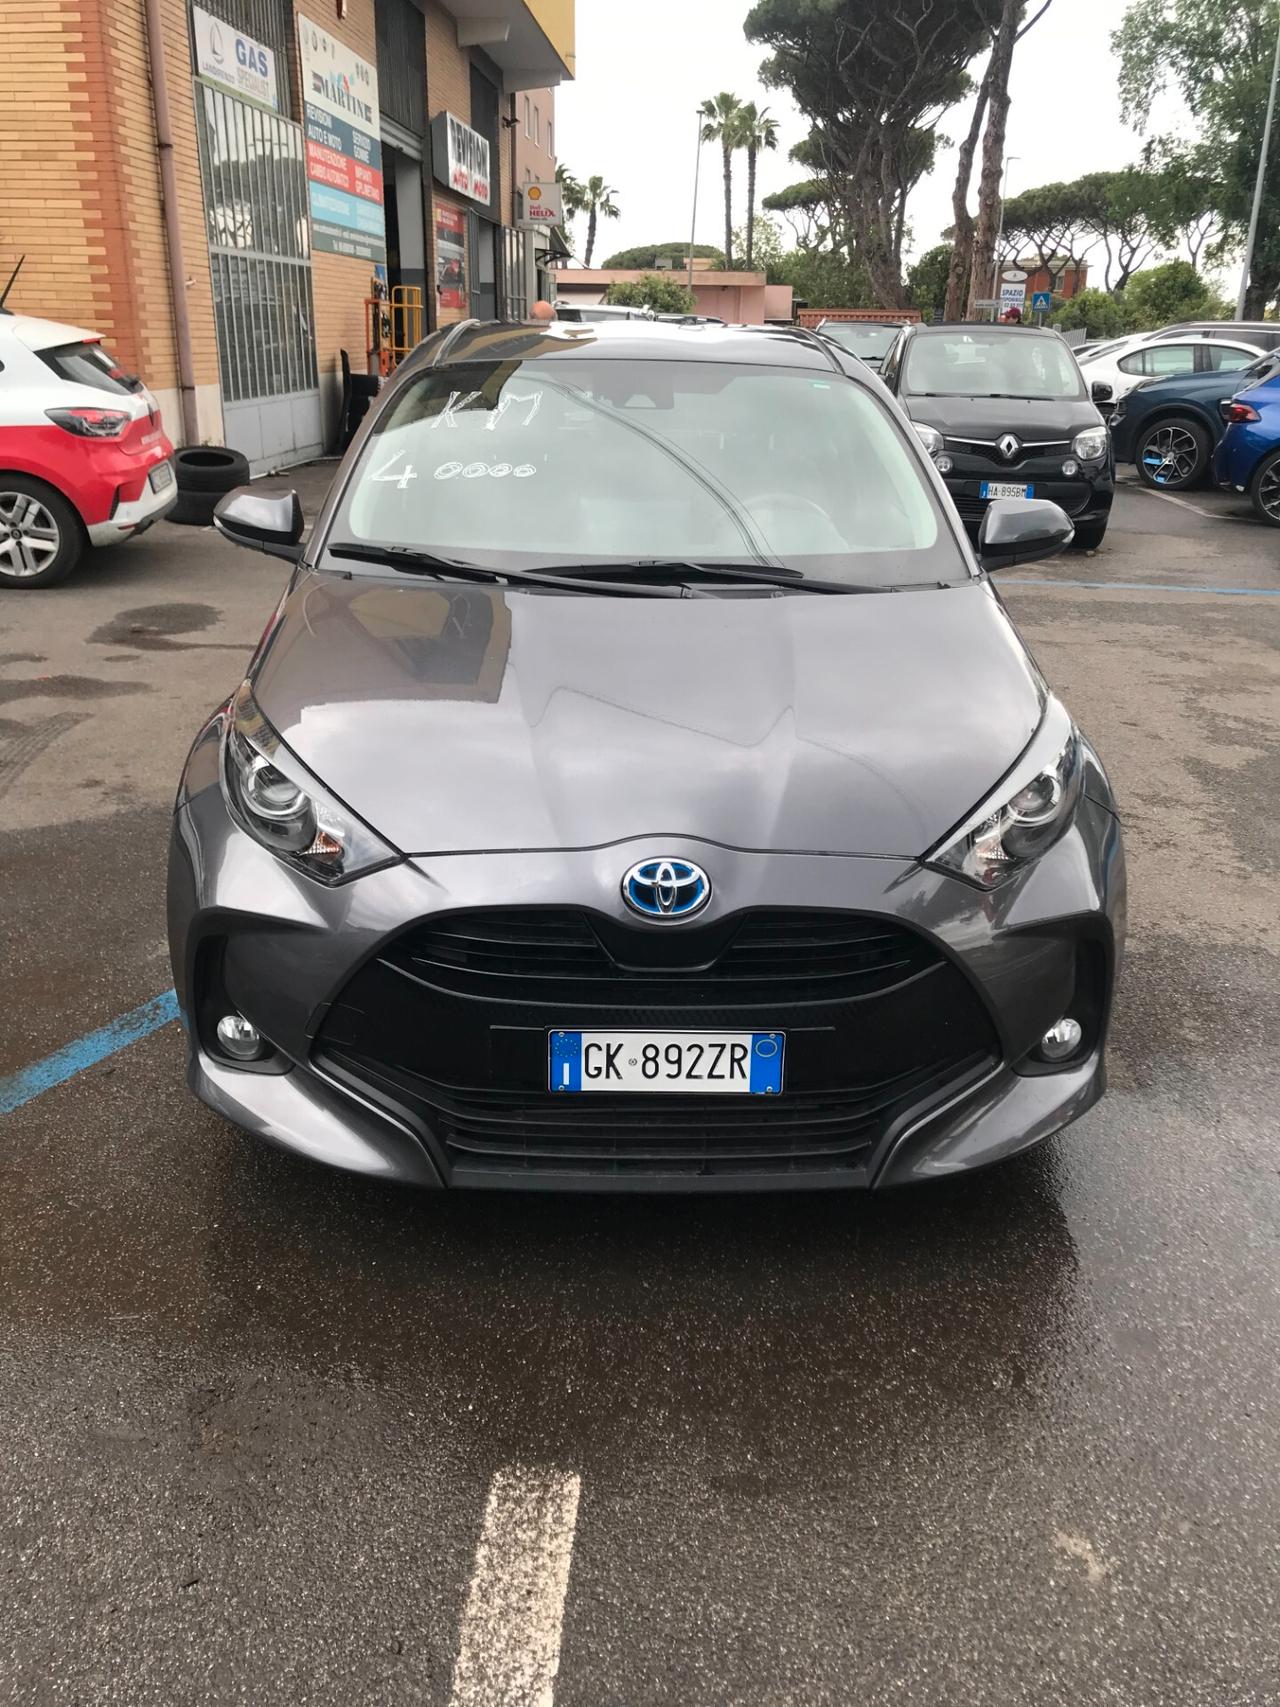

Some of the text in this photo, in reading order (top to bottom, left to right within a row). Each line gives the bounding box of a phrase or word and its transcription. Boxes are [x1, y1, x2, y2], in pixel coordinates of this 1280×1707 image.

[236, 38, 268, 77] GAS
[308, 123, 323, 143] AUTO
[1002, 289, 1024, 297] SPAZIO
[429, 391, 543, 431] KM
[583, 1042, 624, 1080] GK
[641, 1043, 749, 1080] 892ZR
